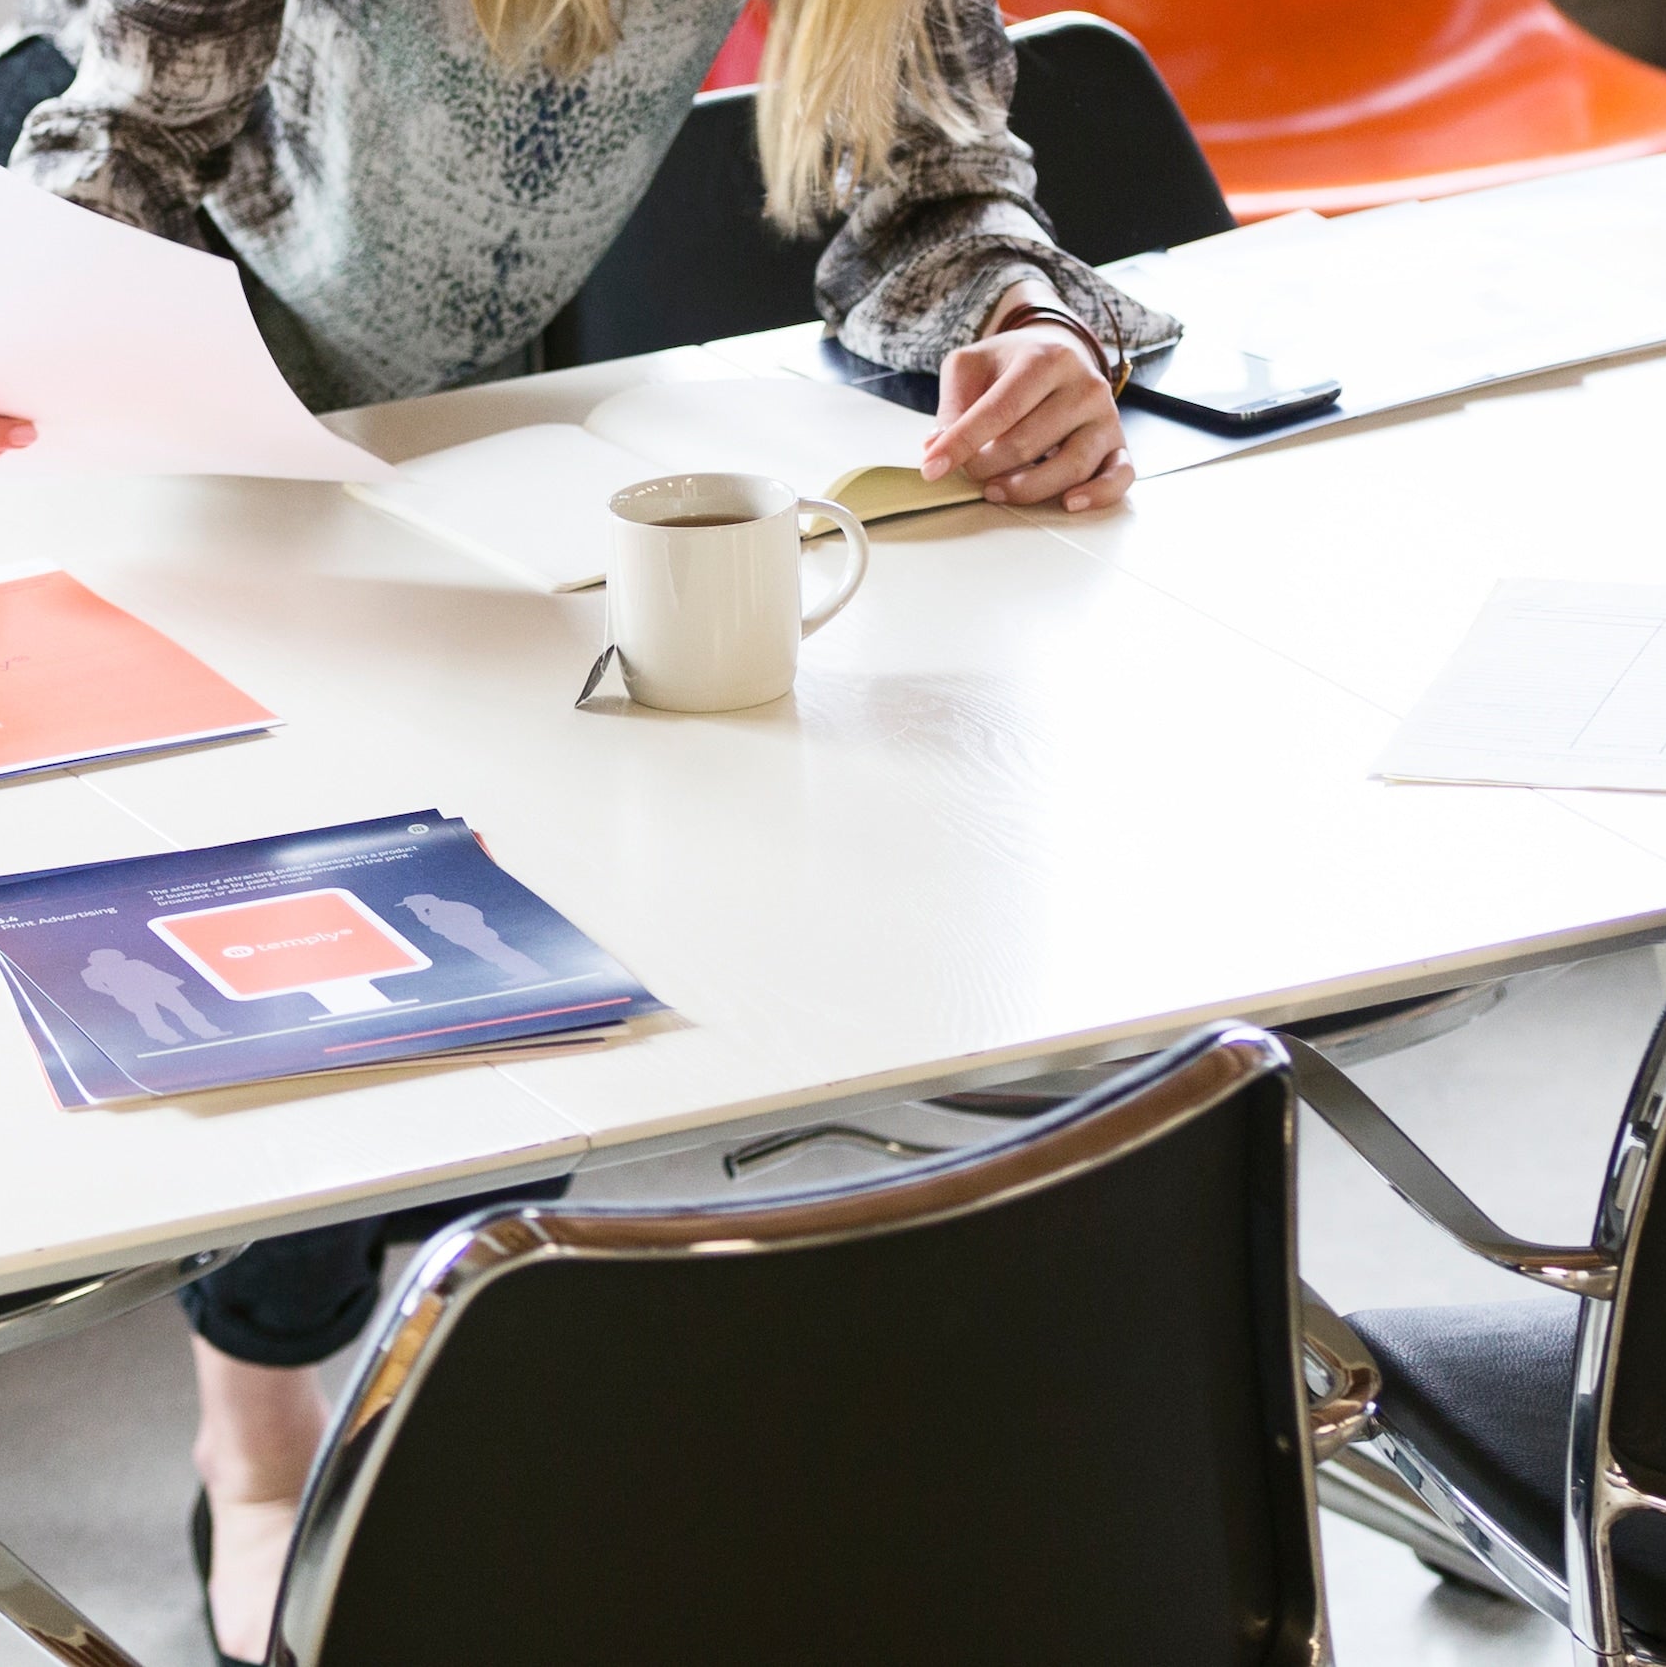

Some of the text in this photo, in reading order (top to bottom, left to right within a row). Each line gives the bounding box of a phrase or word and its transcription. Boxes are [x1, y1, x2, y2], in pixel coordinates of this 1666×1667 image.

[147, 888, 169, 896] The
[170, 882, 208, 893] activity
[223, 870, 275, 883] attracting
[275, 864, 303, 875] public
[308, 855, 354, 869] attention
[378, 845, 420, 857] product
[165, 886, 215, 901] business,
[230, 881, 244, 889] by
[246, 876, 269, 888] paid
[271, 862, 352, 881] announcements
[365, 856, 383, 865] the
[385, 852, 413, 863] print,
[157, 893, 213, 908] broadcast,
[228, 882, 278, 894] electronic
[280, 876, 313, 886] media
[0, 906, 118, 930] Print Advertising
